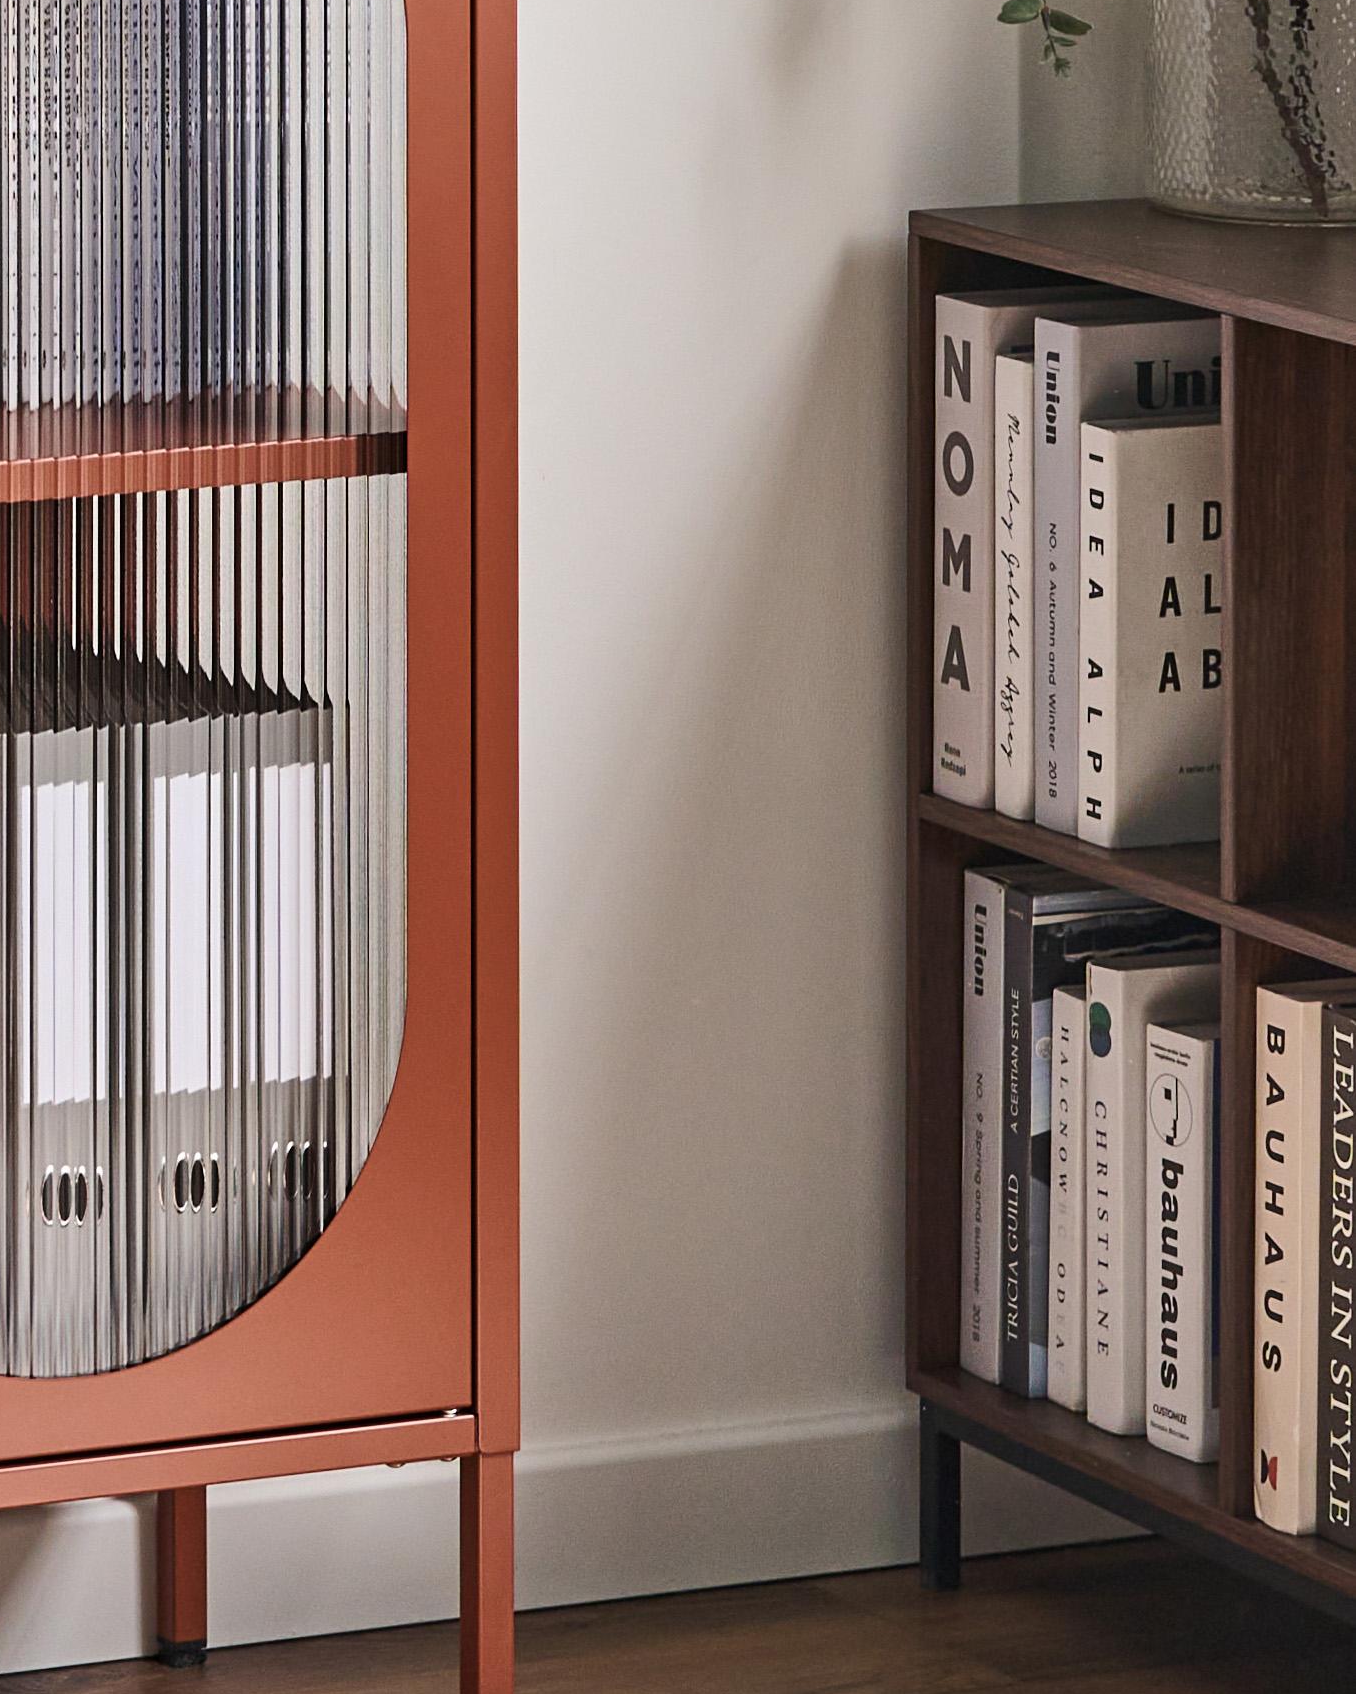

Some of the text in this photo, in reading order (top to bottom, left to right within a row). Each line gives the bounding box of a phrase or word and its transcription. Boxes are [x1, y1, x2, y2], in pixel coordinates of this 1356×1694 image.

[1045, 351, 1060, 445] Union
[941, 334, 974, 692] NOMA
[1049, 580, 1057, 647] Autumn
[1086, 453, 1105, 820] IDEA ALPH
[1048, 651, 1057, 686] and
[1048, 693, 1057, 751] Winter
[1048, 760, 1057, 799] 2018
[974, 904, 987, 996] Union
[1011, 988, 1019, 1040] STYLE
[1011, 1122, 1018, 1134] A
[1095, 1100, 1109, 1357] CHRISTIANE
[1262, 1024, 1285, 1372] BAUHAUS
[1007, 1173, 1019, 1342] TRICIA GUILD
[1160, 1157, 1184, 1390] bauhaus
[1329, 1025, 1354, 1527] LEADERS IN STYLE
